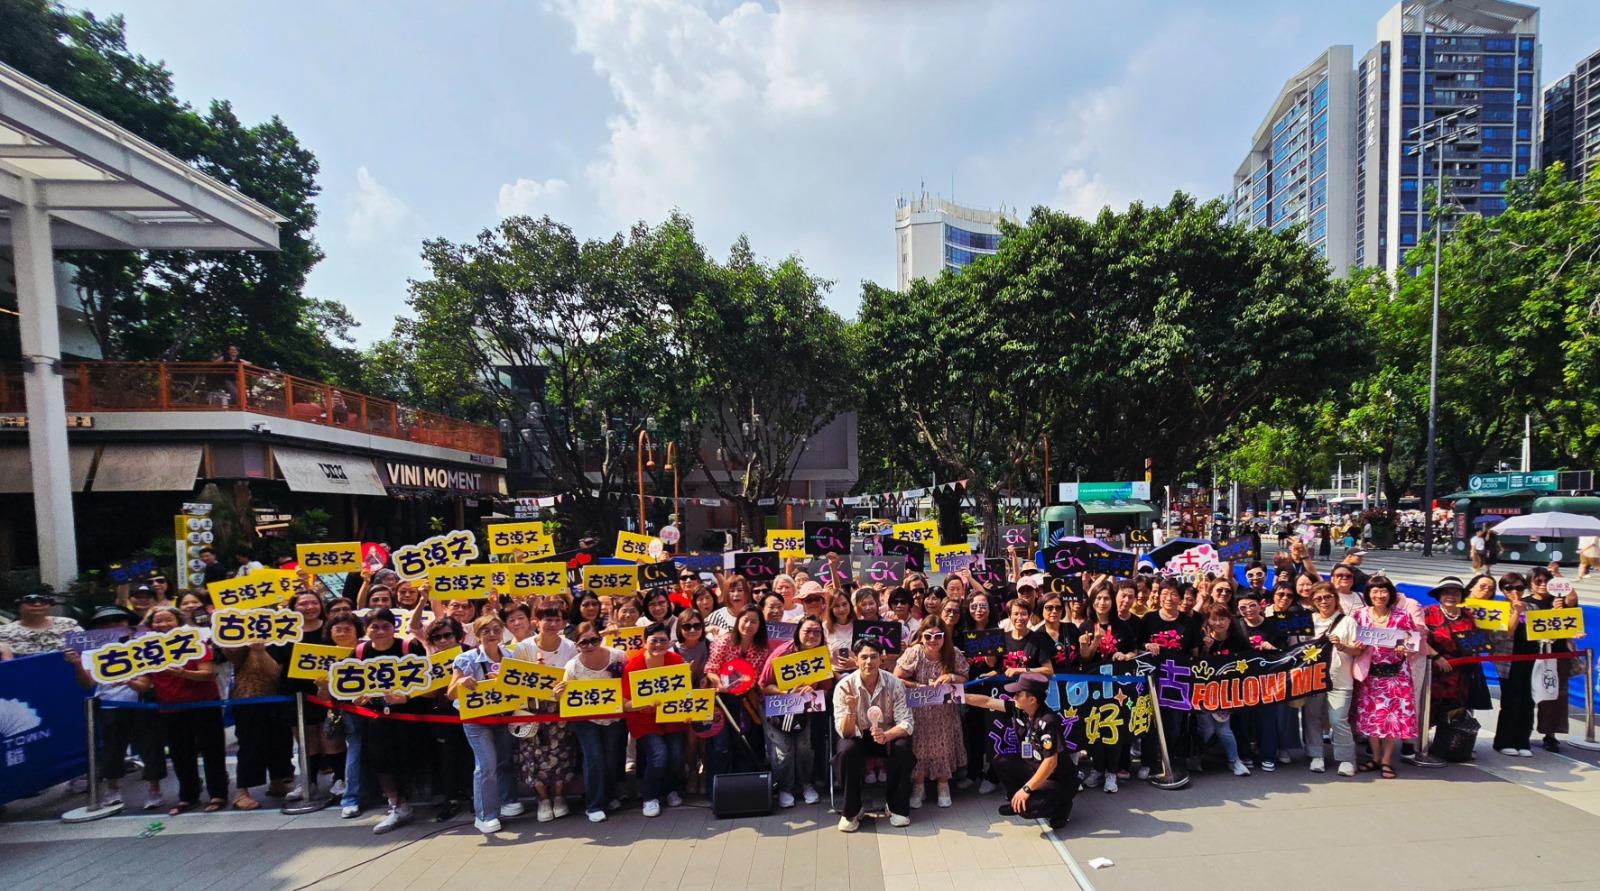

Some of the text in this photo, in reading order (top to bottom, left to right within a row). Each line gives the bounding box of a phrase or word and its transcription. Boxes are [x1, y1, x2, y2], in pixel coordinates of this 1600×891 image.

[387, 463, 481, 490] VINI MOMENT
[612, 634, 643, 650] 古淖
[1158, 659, 1192, 711] 古
[1192, 662, 1327, 711] FOLLOW ME
